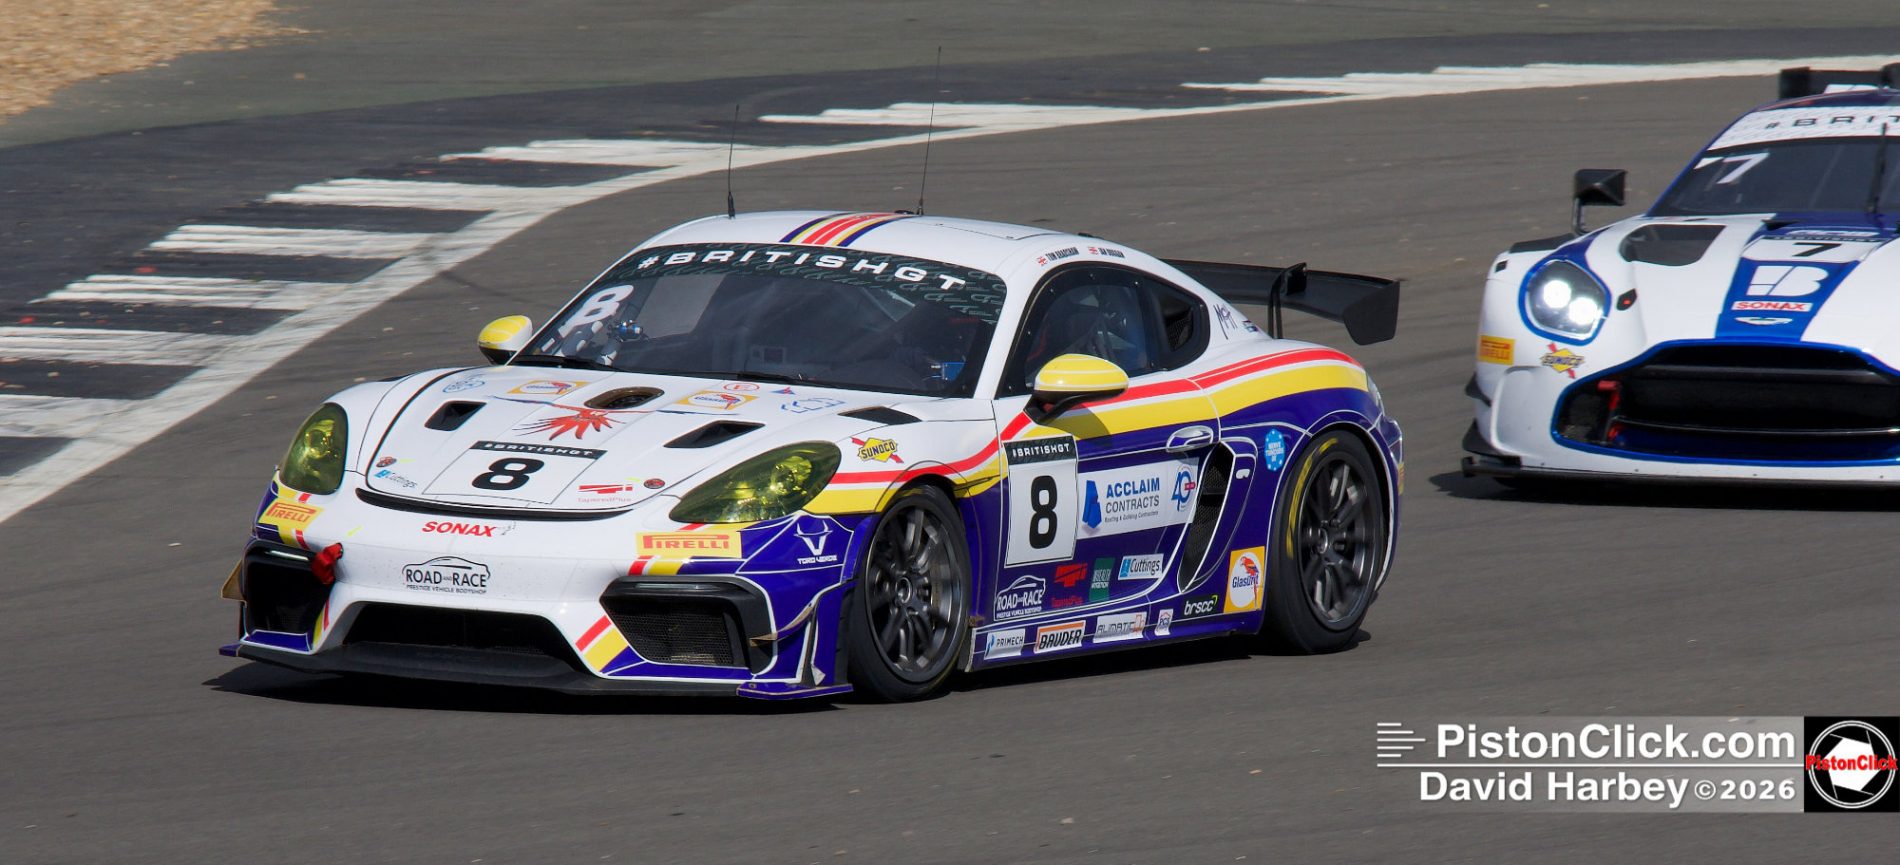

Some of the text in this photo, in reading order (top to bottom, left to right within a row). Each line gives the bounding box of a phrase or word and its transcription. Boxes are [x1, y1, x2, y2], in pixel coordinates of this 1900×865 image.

[1717, 152, 1769, 184] 7
[1792, 242, 1842, 255] 7
[636, 249, 966, 291] #BRITISHGT
[558, 285, 634, 338] 8
[1737, 302, 1805, 310] SONAX
[861, 441, 896, 459] SUNOCO
[472, 458, 544, 490] 8
[1106, 478, 1160, 499] ACCLAIM
[265, 502, 317, 523] PIRELLI
[1029, 475, 1058, 549] 8
[1105, 495, 1160, 514] CONTRACTS
[421, 521, 497, 537] SONAX
[643, 534, 730, 549] PIRELLI
[1130, 558, 1161, 576] Cuttings
[406, 569, 442, 585] ROAD
[452, 572, 487, 588] RACE
[997, 593, 1018, 611] ROAD
[1022, 589, 1043, 608] RACE
[1184, 600, 1214, 616] brscc
[996, 636, 1024, 647] PRIMECH
[1038, 629, 1082, 650] BAUDER
